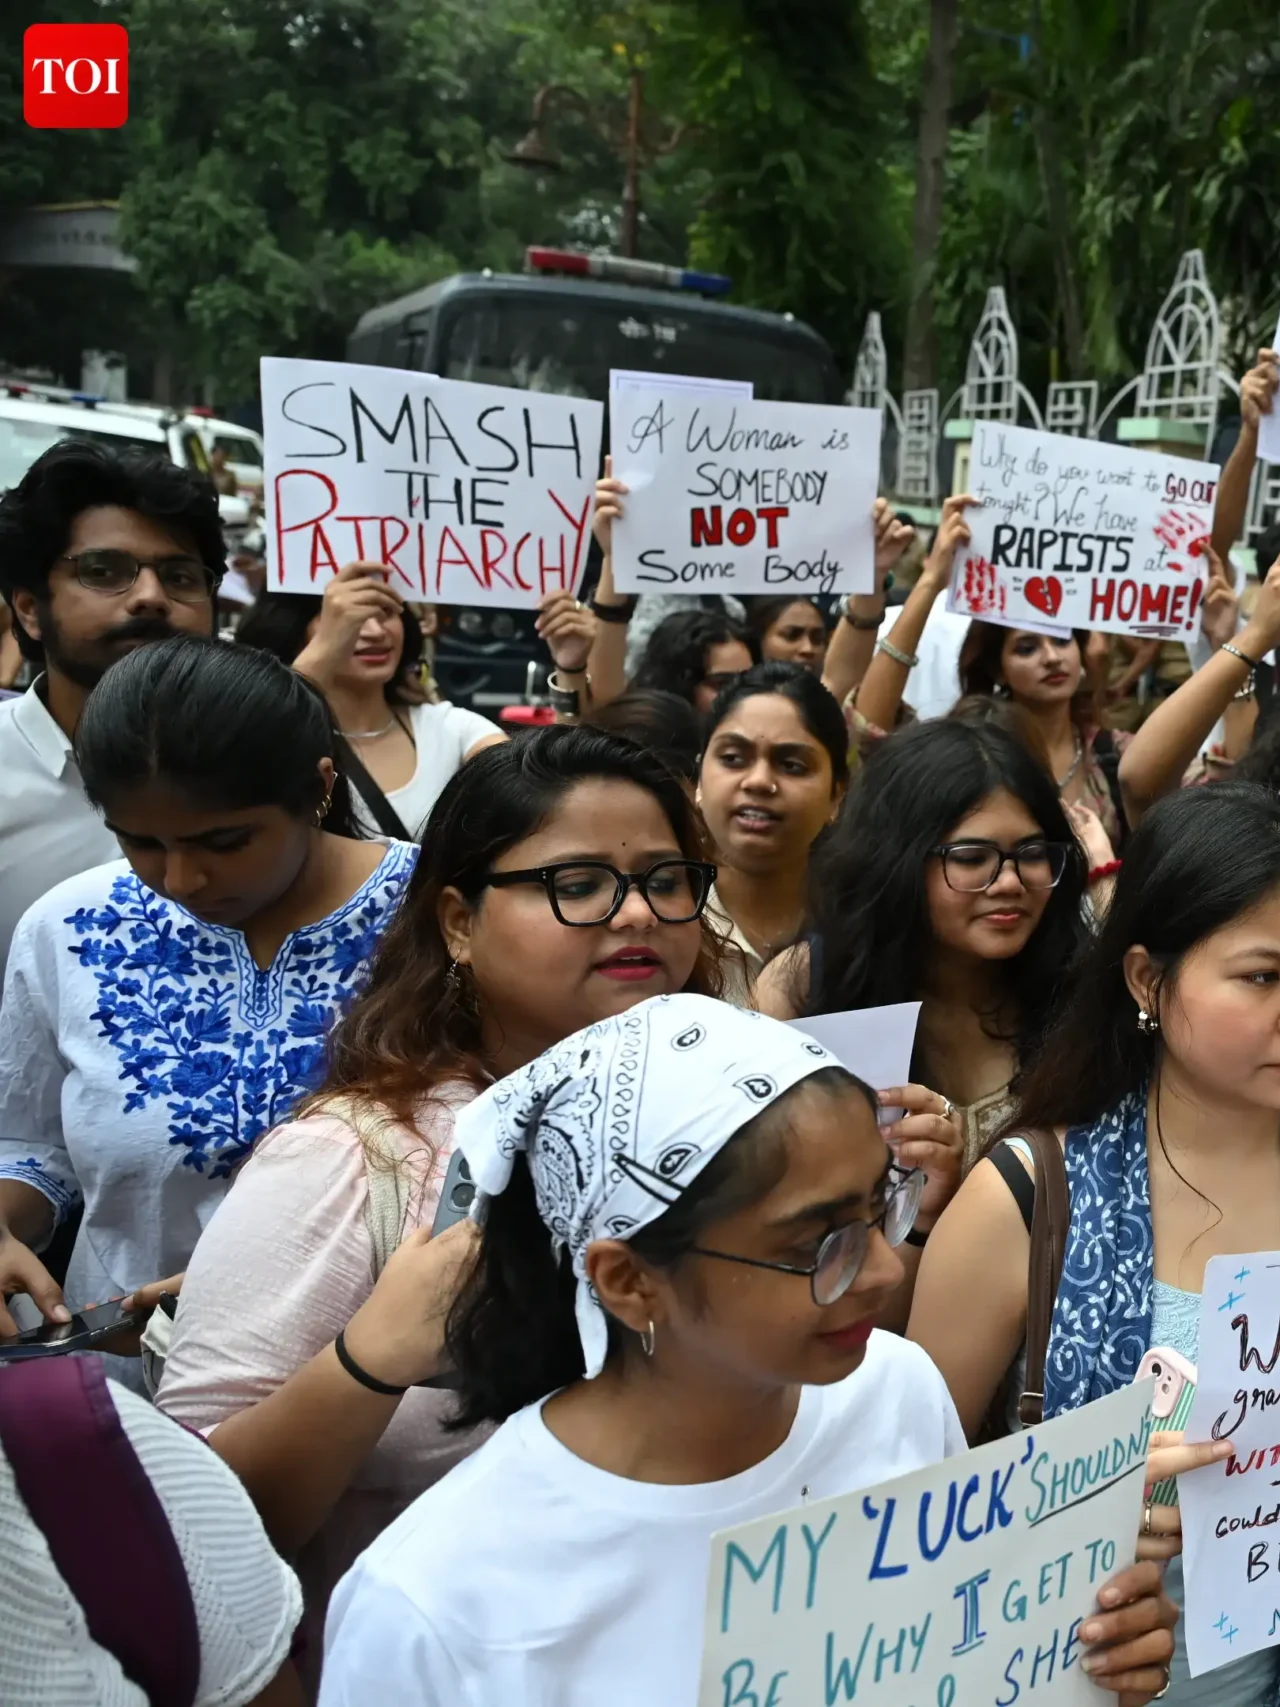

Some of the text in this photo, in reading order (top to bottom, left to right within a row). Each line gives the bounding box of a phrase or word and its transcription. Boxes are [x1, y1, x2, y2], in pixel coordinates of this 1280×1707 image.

[281, 382, 582, 479] SMASH
[627, 399, 850, 454] A Woman is
[687, 461, 828, 506] SOMEBODY
[980, 428, 1019, 488] Why
[1025, 446, 1049, 476] do
[1053, 464, 1091, 494] you
[1096, 466, 1136, 487] want
[1143, 469, 1162, 493] to
[1164, 472, 1188, 504] GO
[384, 468, 510, 529] THE
[1052, 486, 1089, 528] We
[274, 468, 592, 597] PATRIARCHY
[690, 504, 790, 549] NOT
[990, 523, 1134, 574] RAPISTS
[635, 549, 845, 594] Some Body
[1089, 576, 1204, 631] HOME!
[720, 1512, 838, 1634] MY
[824, 1611, 932, 1707] WHY
[951, 1568, 992, 1657] I
[1001, 1550, 1074, 1623] GET
[1084, 1537, 1116, 1585] TO
